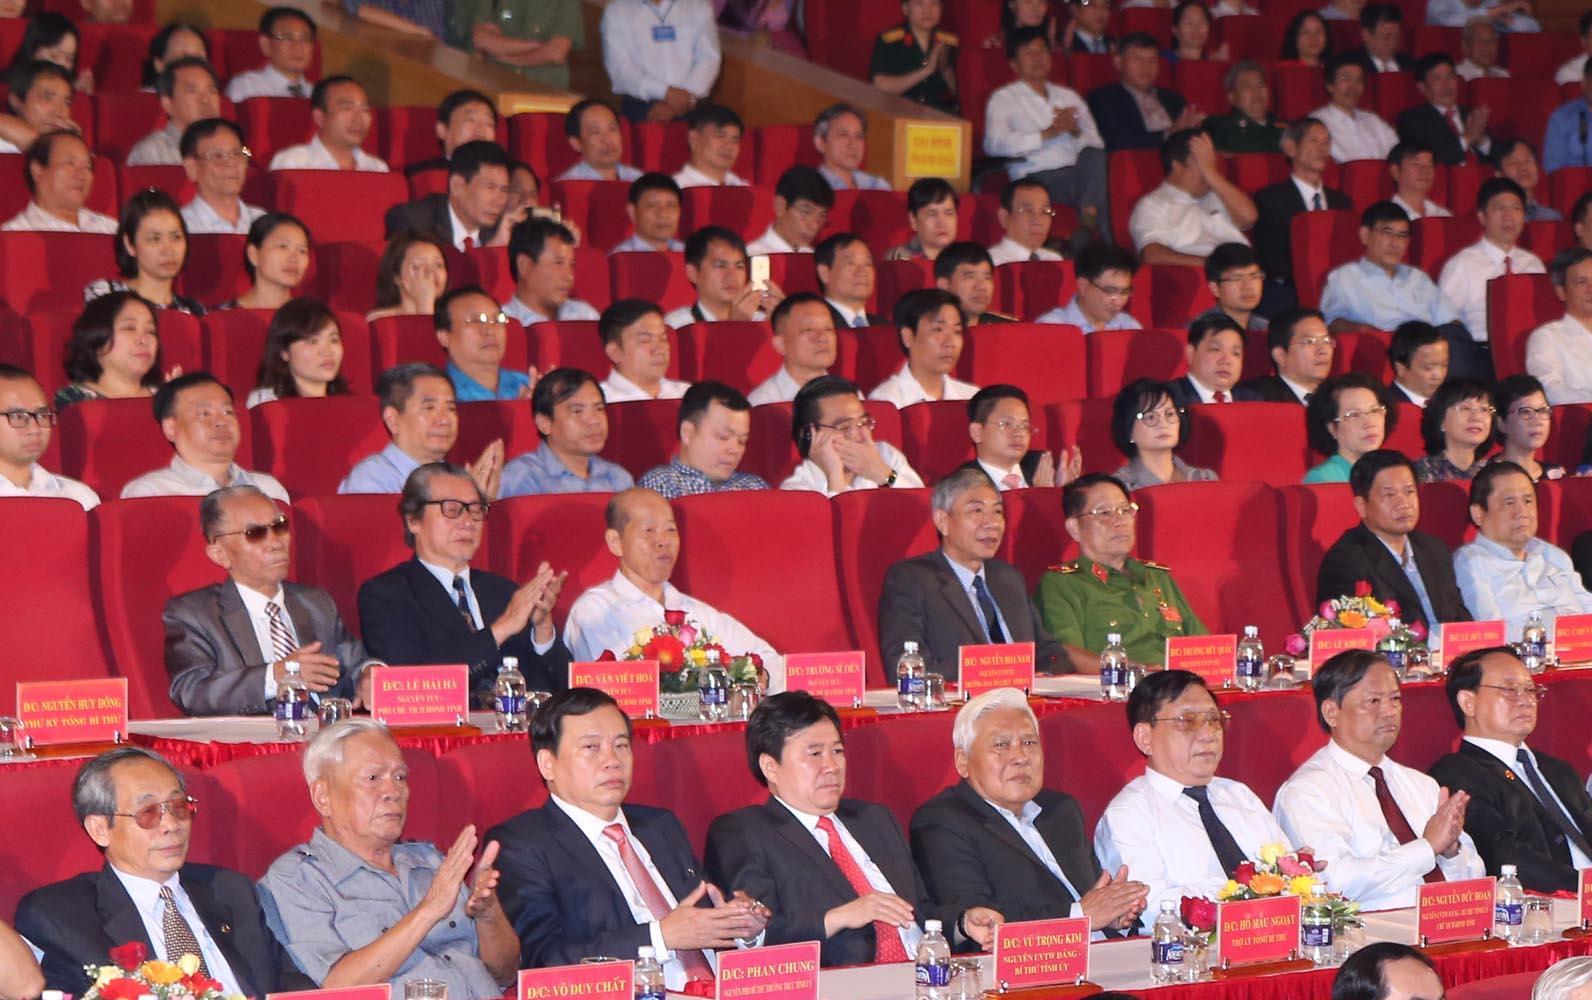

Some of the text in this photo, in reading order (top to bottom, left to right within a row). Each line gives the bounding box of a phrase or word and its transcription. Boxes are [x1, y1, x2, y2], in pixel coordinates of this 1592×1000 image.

[1065, 932, 1082, 943] KIM
[747, 964, 776, 977] PHAN
[777, 960, 814, 975] CHUNG
